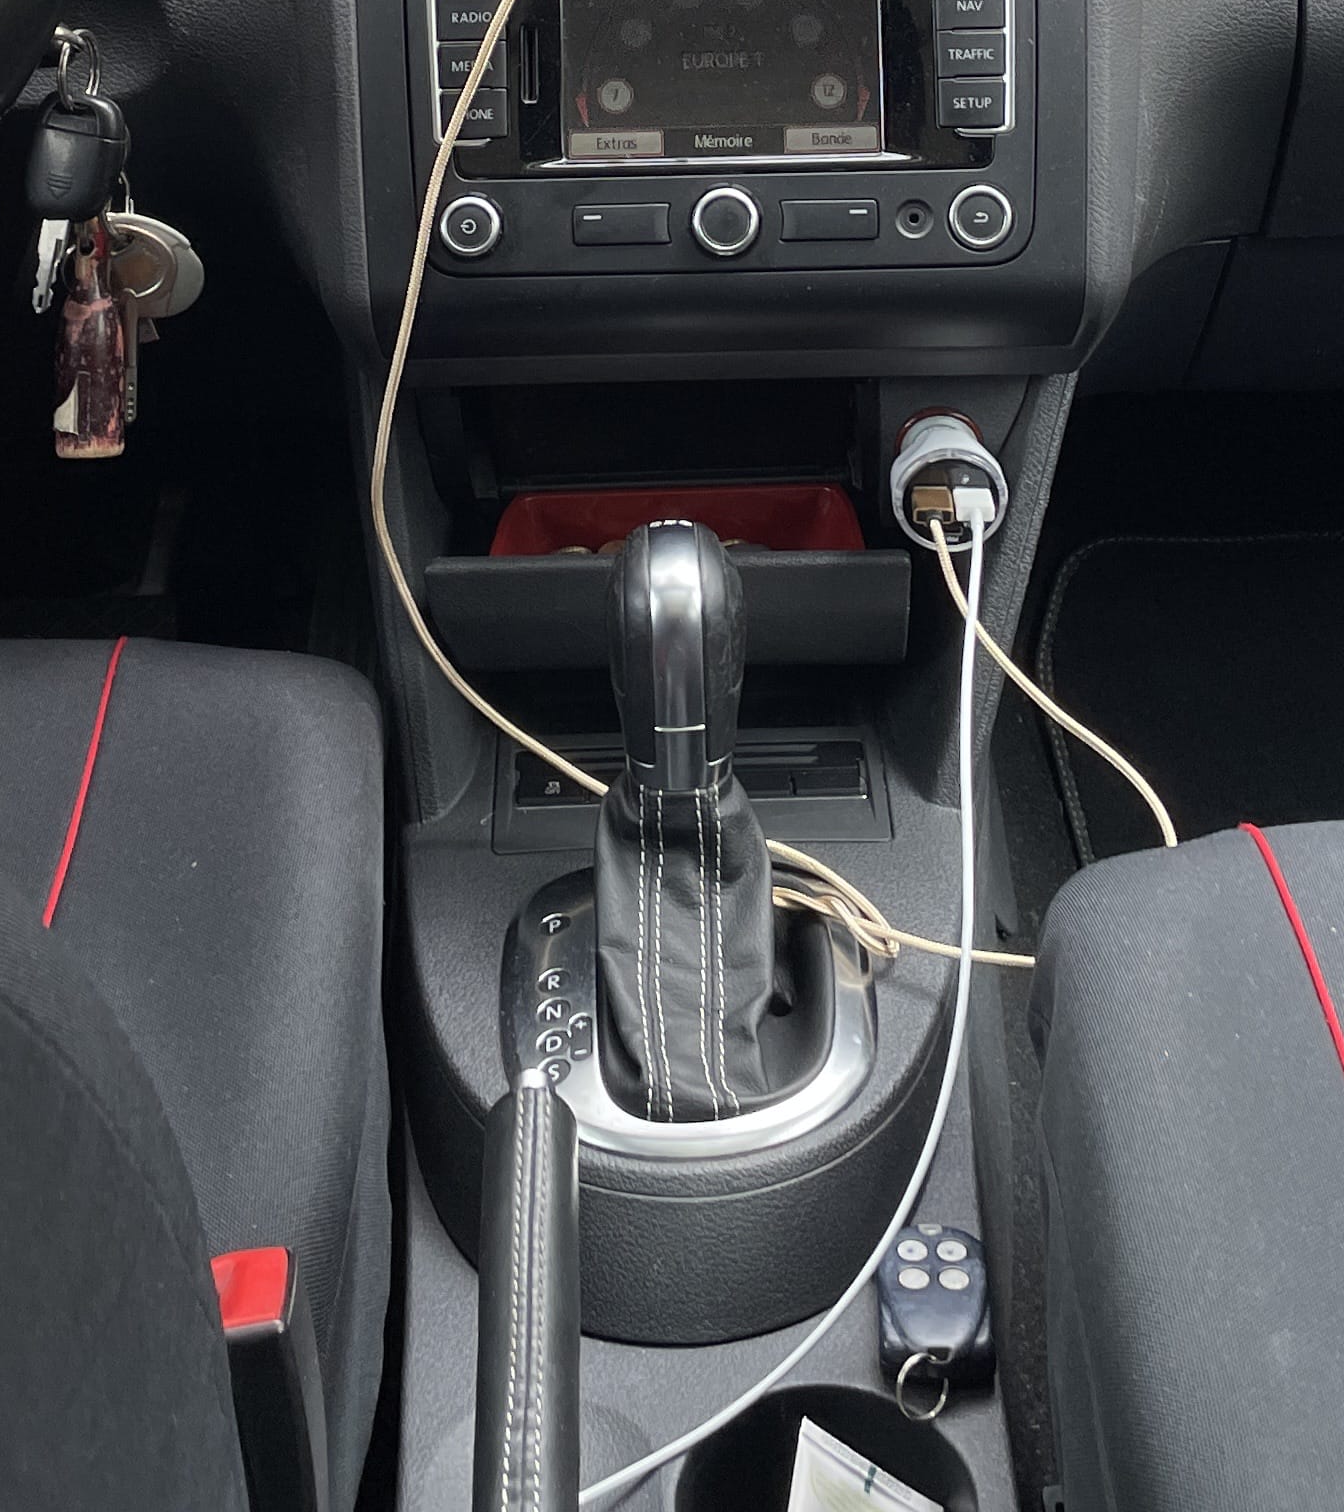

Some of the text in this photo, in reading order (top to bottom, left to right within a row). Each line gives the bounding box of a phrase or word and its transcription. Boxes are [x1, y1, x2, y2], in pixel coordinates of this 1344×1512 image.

[956, 0, 984, 11] NAV
[451, 11, 493, 24] RADIO
[948, 48, 995, 60] TRAFFIC
[451, 59, 494, 72] MEA
[952, 96, 992, 109] SETUP
[596, 132, 853, 151] Extras Mémoire Bande
[549, 918, 562, 934] P
[547, 974, 561, 990] R
[545, 1003, 562, 1021] N
[545, 1036, 563, 1053] D
[548, 1063, 561, 1082] S
